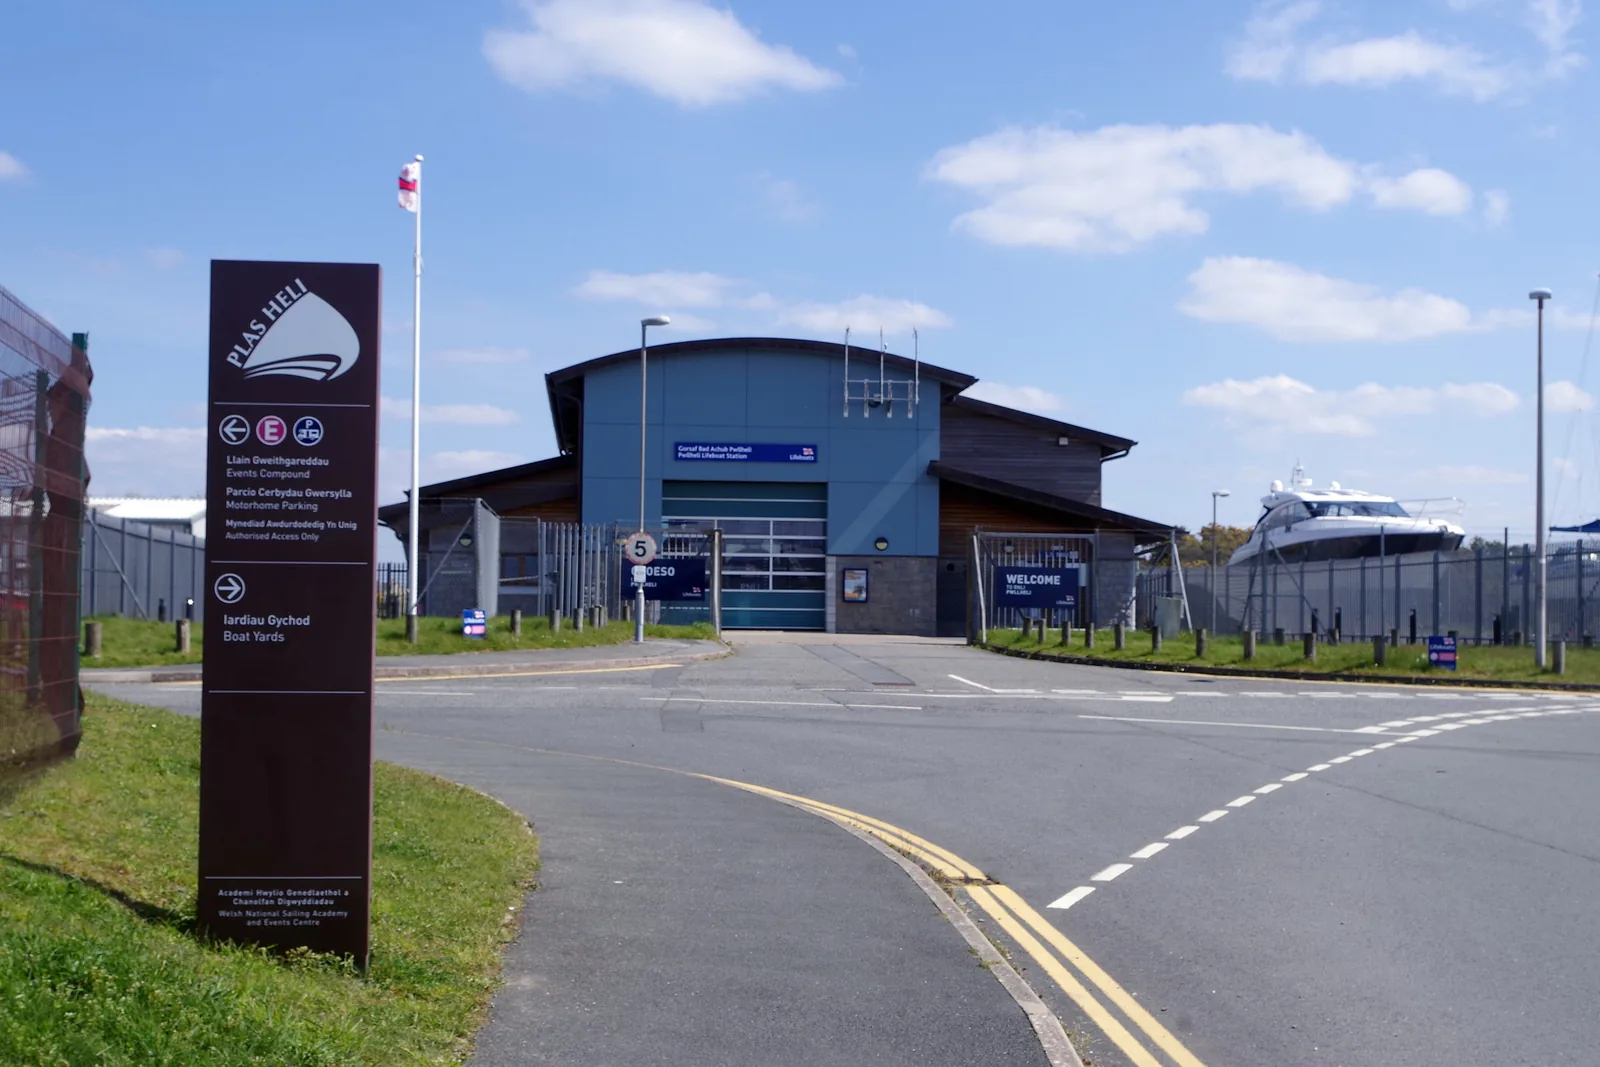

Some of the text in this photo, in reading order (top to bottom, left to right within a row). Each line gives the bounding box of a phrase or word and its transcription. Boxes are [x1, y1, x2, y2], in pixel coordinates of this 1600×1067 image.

[226, 278, 308, 368] PLAS HELI
[306, 420, 313, 429] P
[264, 420, 278, 441] E
[227, 456, 329, 467] Llain Gweithgareddau
[227, 469, 310, 480] Events Compound
[226, 487, 352, 499] Parcio Cerbydau Gwersylla
[226, 501, 318, 512] Motorhome Parking
[225, 520, 265, 528] Mynediad
[266, 520, 325, 530] Awdurdodedig
[338, 521, 357, 530] Unig
[225, 532, 319, 542] Authorised Access Only
[635, 541, 646, 557] 5
[1006, 574, 1061, 585] WELCOME
[224, 614, 310, 628] Iardiau Gychod
[224, 631, 285, 642] Boat Yards
[256, 889, 284, 898] Hwylio
[287, 889, 341, 897] Genedlaethol
[277, 898, 334, 906] Digwyddiadau
[282, 910, 310, 918] Sailing
[312, 910, 348, 918] Academy
